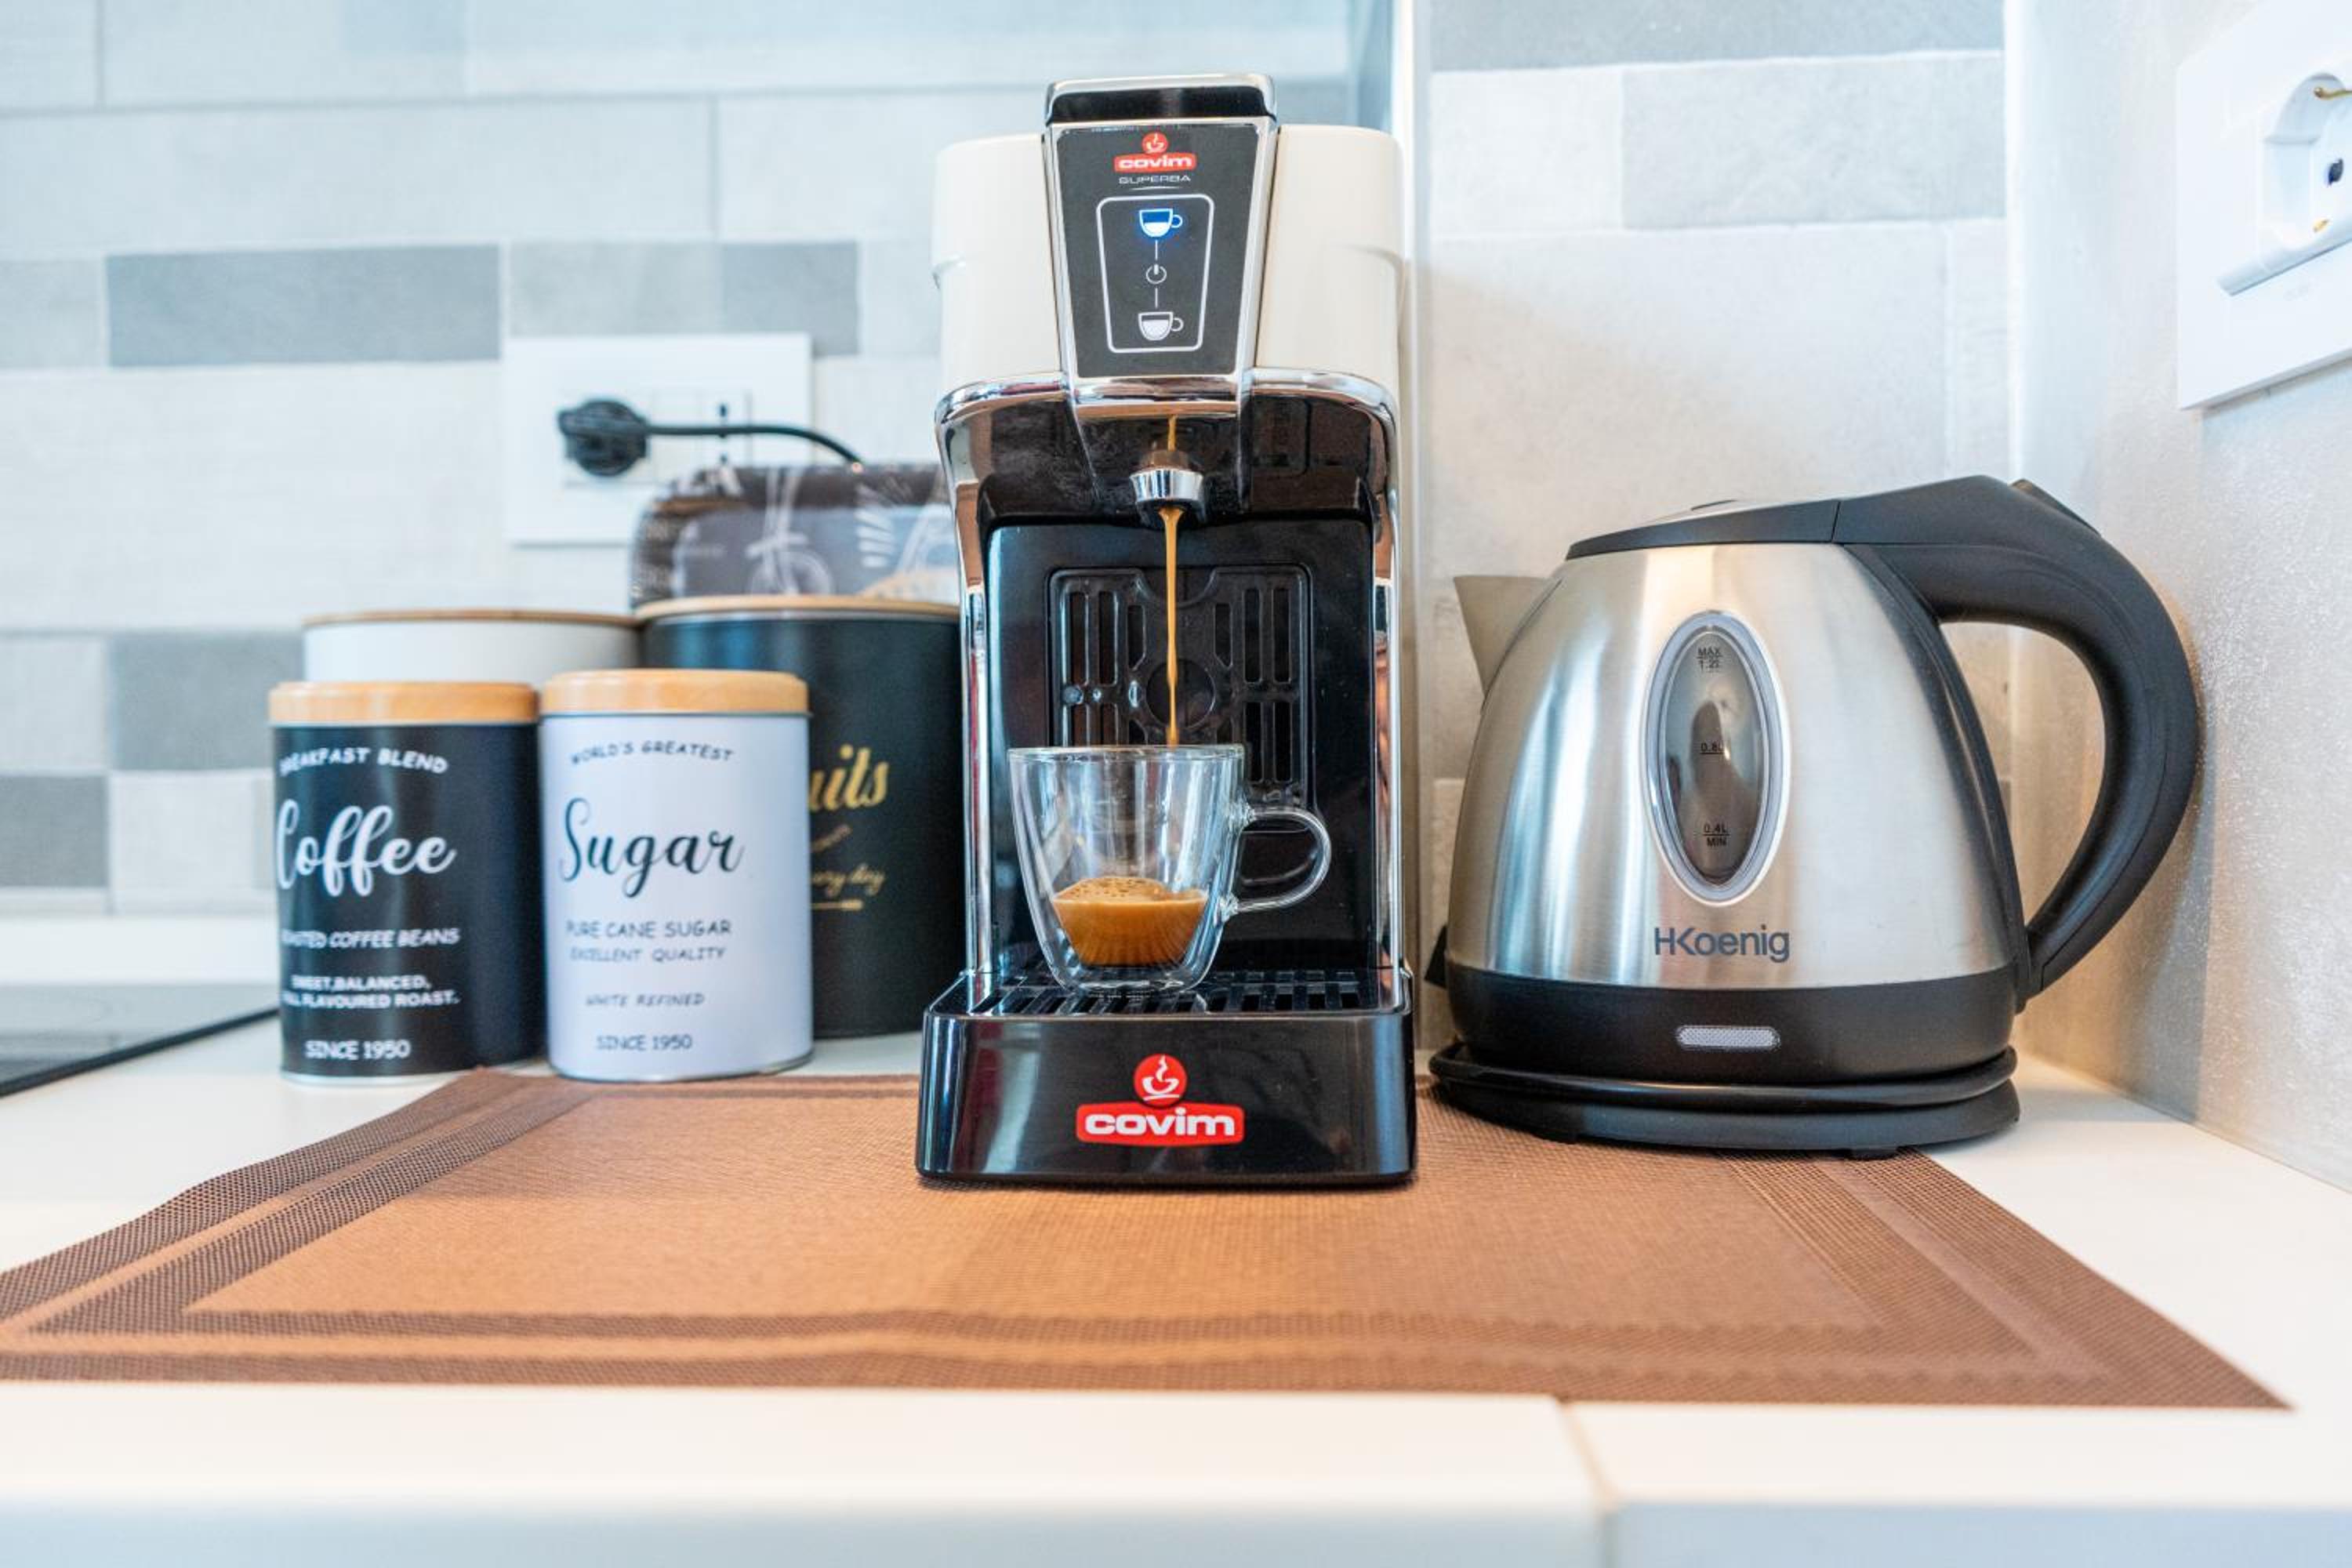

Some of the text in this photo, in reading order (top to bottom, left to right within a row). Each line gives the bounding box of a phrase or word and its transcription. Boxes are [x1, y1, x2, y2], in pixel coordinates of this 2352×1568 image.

[1119, 155, 1192, 169] covim
[1119, 174, 1191, 184] SUPERBA
[1697, 647, 1722, 657] MAX
[641, 740, 735, 762] GREATEST
[376, 749, 448, 774] BLEND
[1704, 824, 1727, 833] 0.4L
[557, 797, 746, 899] Sugar
[1707, 837, 1727, 847] MIN
[329, 930, 394, 949] COFFEE
[396, 927, 460, 948] BEANS
[565, 920, 732, 938] PURE CANE SUGAR
[1654, 924, 1790, 963] HKoenig
[570, 946, 726, 964] EXCELLENT QUALITY
[586, 993, 706, 1007] WHITE REFINED
[304, 1039, 412, 1060] SINCE 1950
[596, 1034, 693, 1051] SINCE 1950
[1084, 1106, 1236, 1136] covim
